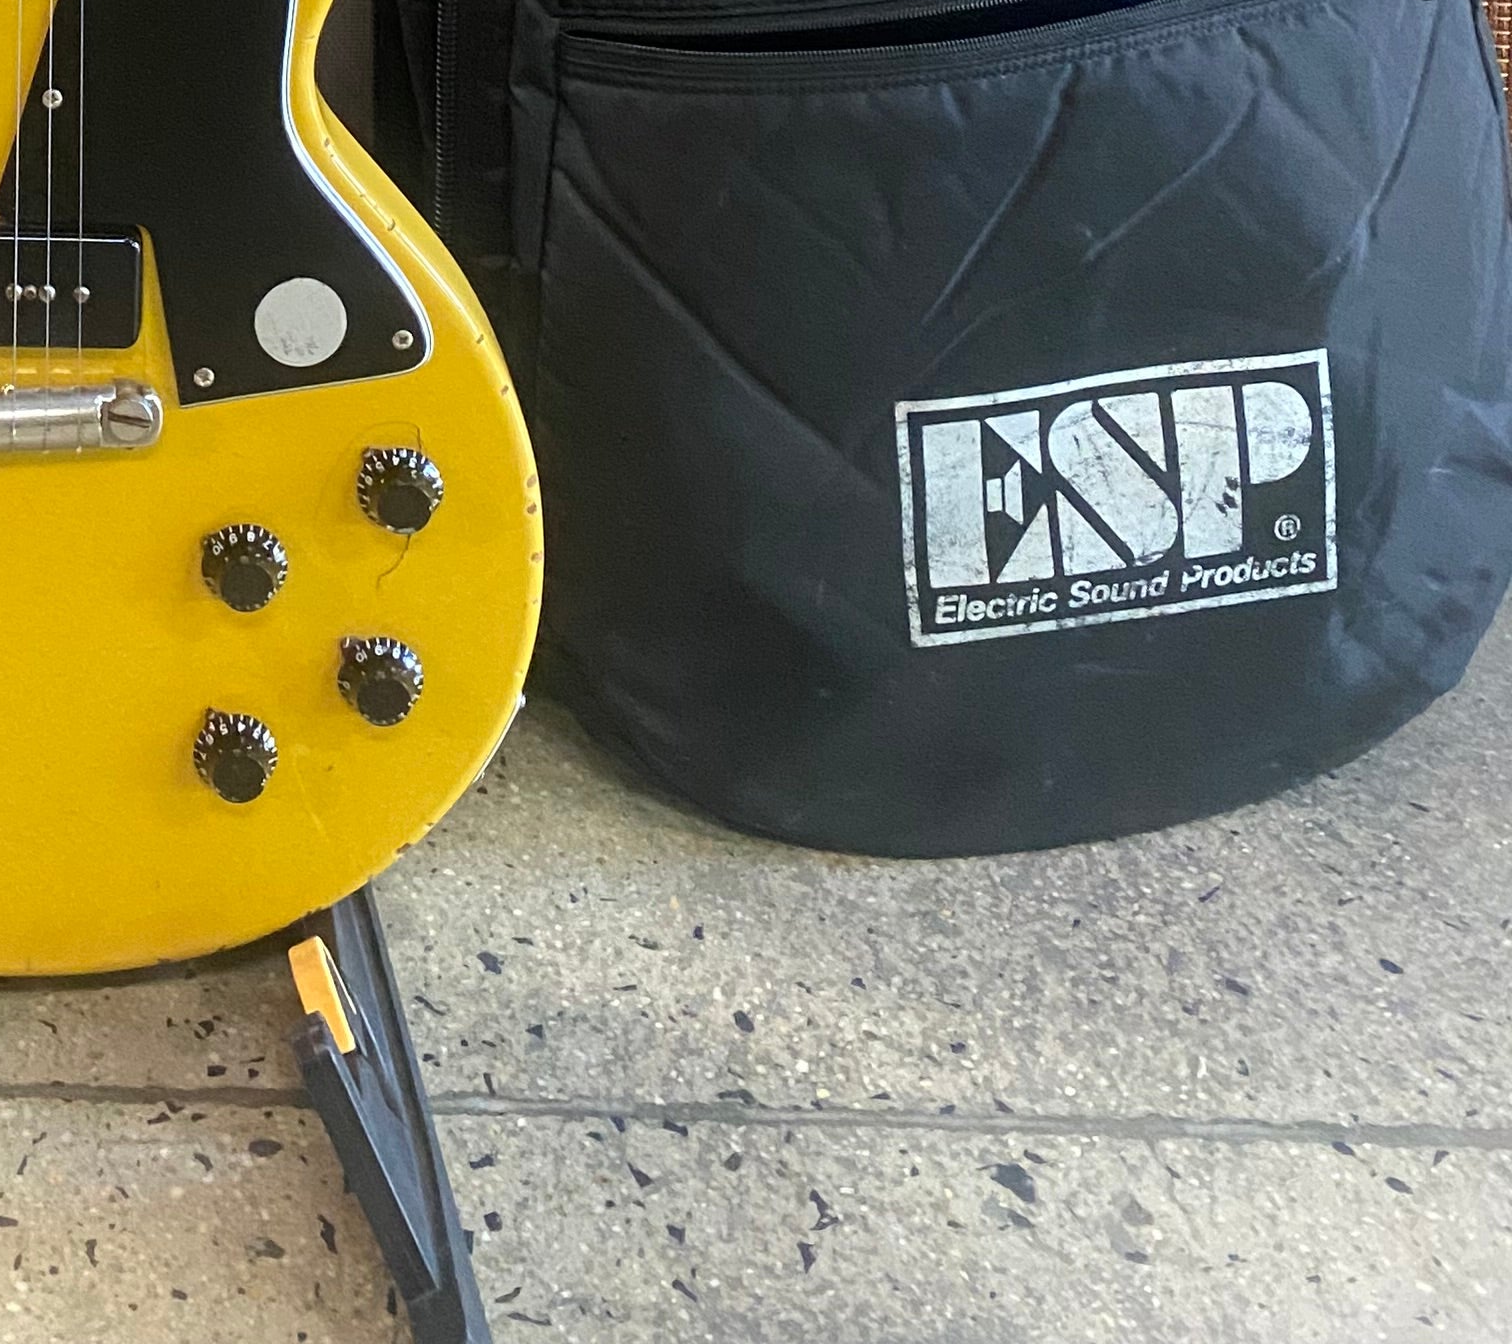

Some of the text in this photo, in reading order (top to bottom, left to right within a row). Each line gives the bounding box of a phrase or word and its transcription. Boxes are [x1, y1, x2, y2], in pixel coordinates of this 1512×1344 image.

[922, 381, 1314, 589] ESP
[934, 549, 1317, 625] Electric Sound Products
